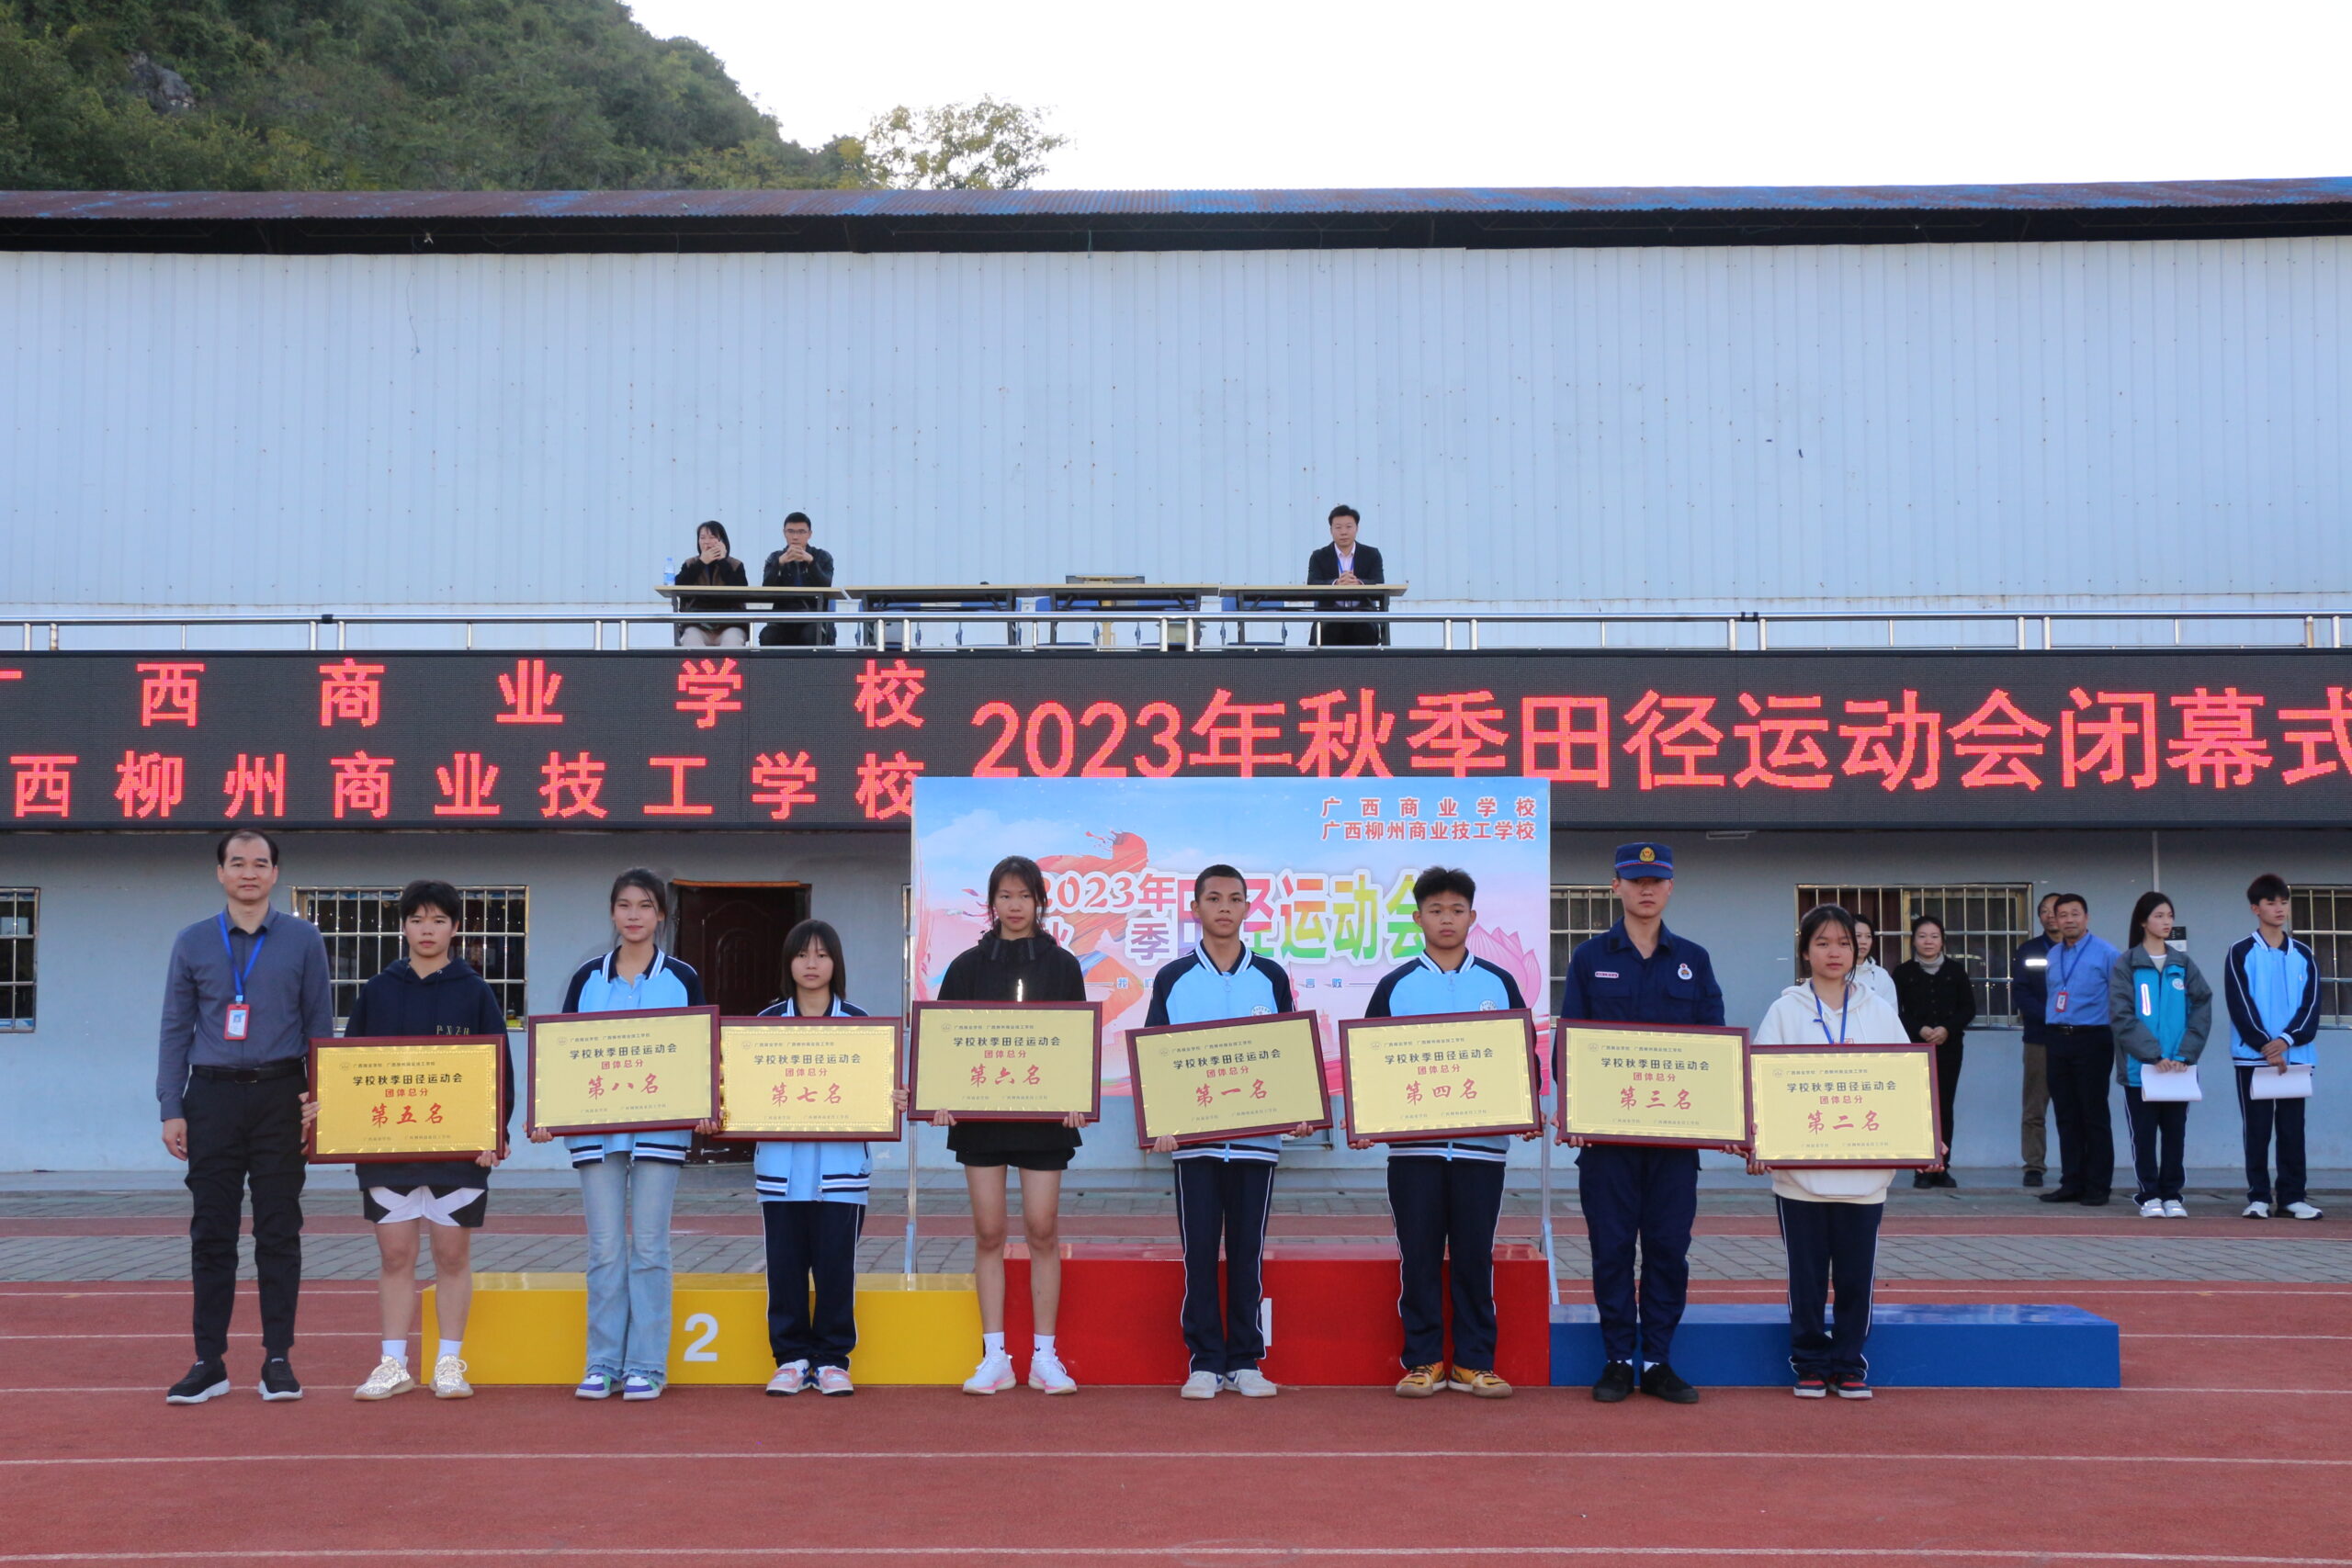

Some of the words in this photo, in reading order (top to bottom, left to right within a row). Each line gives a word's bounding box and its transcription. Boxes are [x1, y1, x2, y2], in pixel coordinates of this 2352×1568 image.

[0, 659, 925, 728] 西商业学校
[1321, 797, 1535, 817] 广西商业学校
[1321, 820, 1535, 840] 广西柳州商业技工学校
[954, 1037, 1060, 1046] 学校秋季田径运动会
[570, 1043, 677, 1059] 学校秋季田径运动会
[754, 1054, 860, 1064] 学校秋季田径运动会
[1173, 1049, 1281, 1069] 学校秋季田径运动会
[1385, 1048, 1493, 1065] 学校秋季田径运动会
[601, 1059, 643, 1069] 团体总分
[786, 1068, 828, 1077] 团体总分
[1206, 1066, 1249, 1078] 团体总分
[1418, 1065, 1461, 1075] 团体总分
[1601, 1058, 1710, 1070] 学校秋季田径运动会
[353, 1073, 462, 1086] 学校秋季田径运动会
[970, 1064, 1040, 1088] 第六名
[1634, 1073, 1676, 1082] 团体总分
[385, 1089, 428, 1097] 团体总分
[588, 1073, 659, 1100] 第八名
[772, 1082, 842, 1107] 第七名
[1196, 1079, 1267, 1108] 第一名
[1406, 1078, 1477, 1105] 第四名
[1787, 1081, 1896, 1092] 学校秋季田径运动会
[1620, 1086, 1691, 1111] 第三名
[1820, 1096, 1862, 1104] 团体总分
[371, 1103, 443, 1128] 第五名
[1808, 1110, 1880, 1134] 第二名
[684, 1313, 718, 1361] 2
